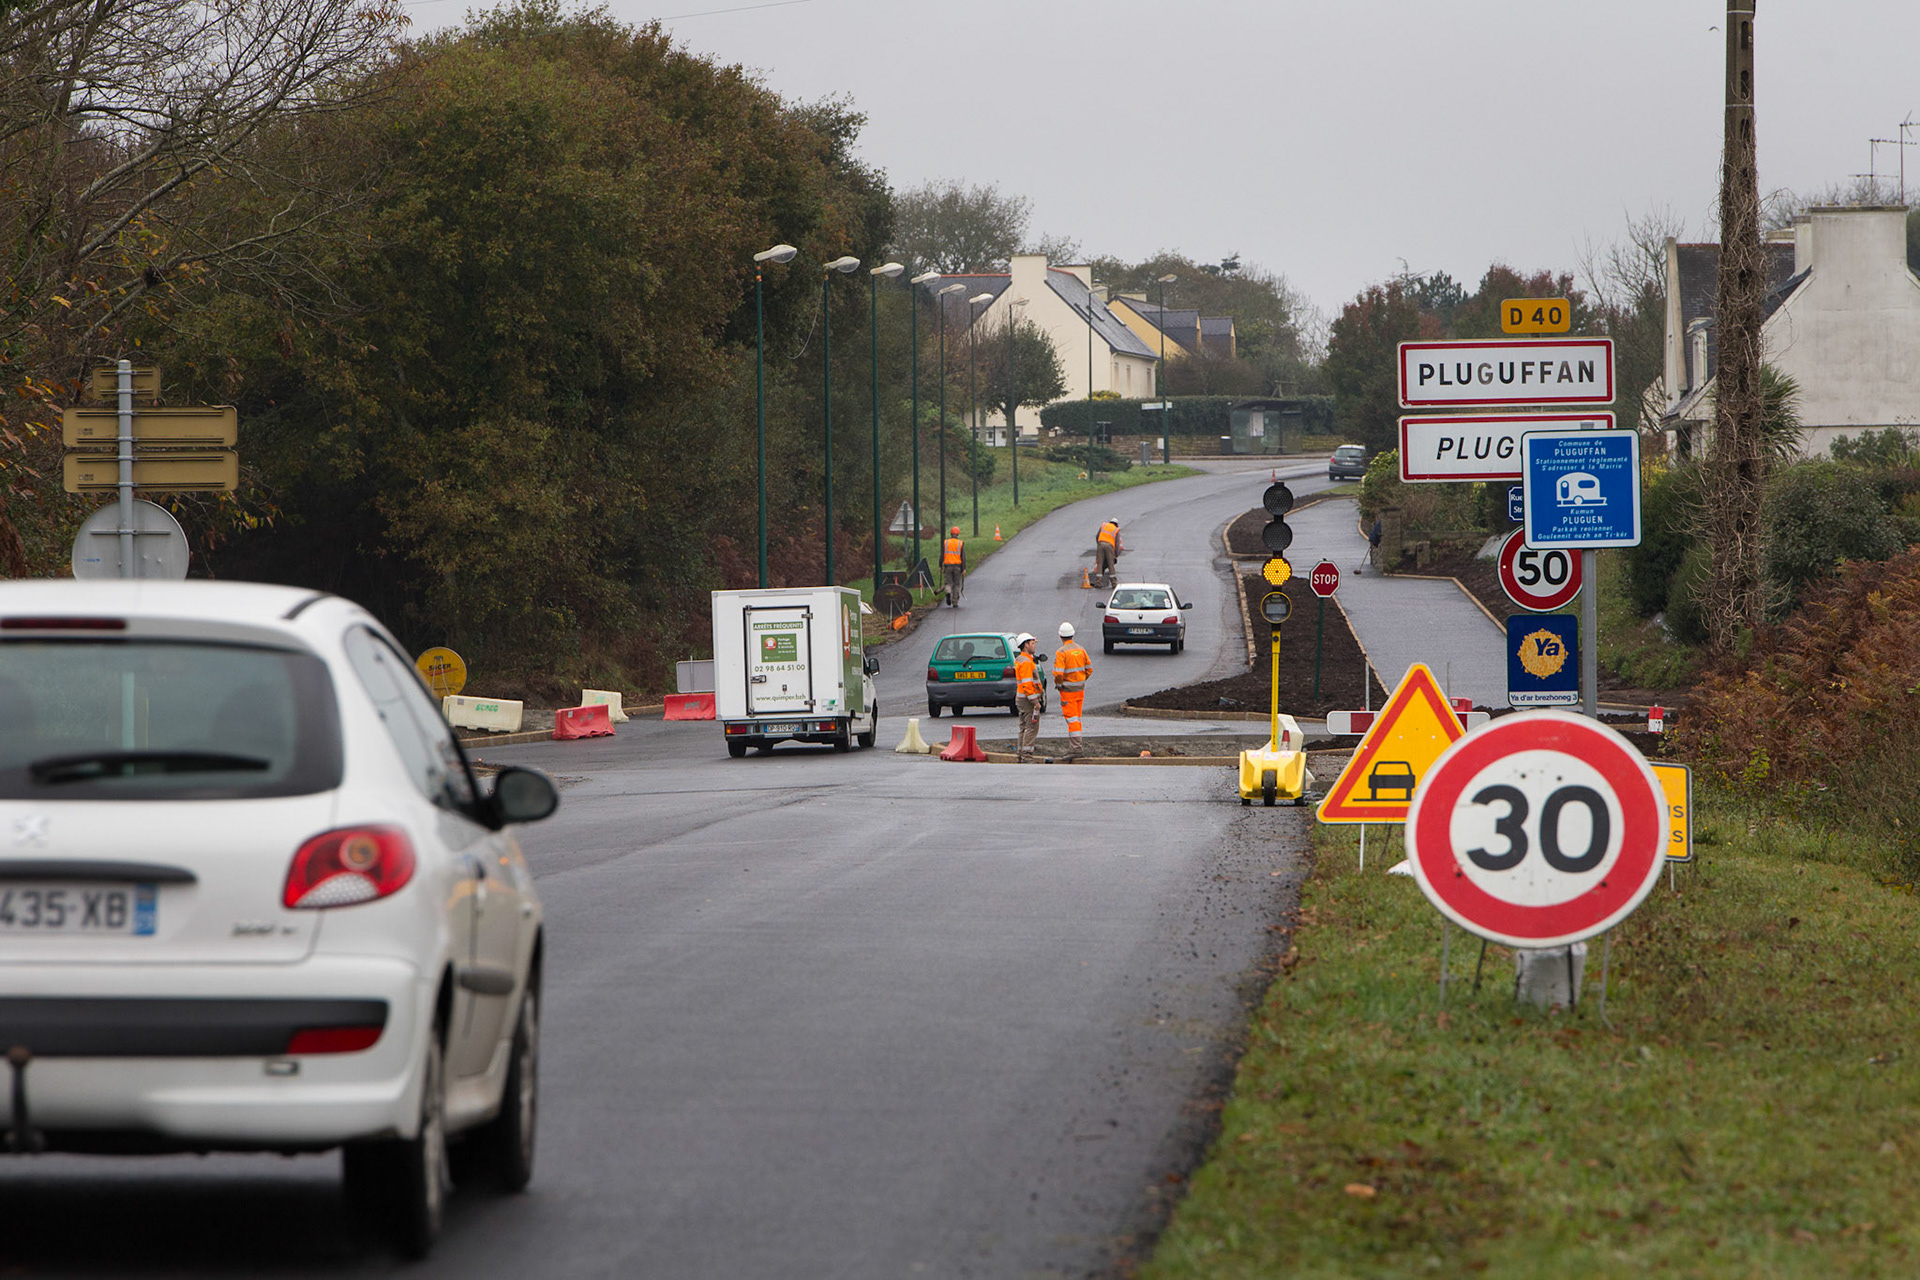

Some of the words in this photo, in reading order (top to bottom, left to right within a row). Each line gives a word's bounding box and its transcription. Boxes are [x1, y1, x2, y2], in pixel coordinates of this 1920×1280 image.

[1510, 308, 1522, 325] D
[1532, 307, 1562, 325] 40
[1418, 360, 1595, 386] PLUGUFFAN
[1437, 436, 1523, 460] PLUG
[1554, 447, 1606, 457] PLUGUFFAN
[1535, 457, 1585, 465] Stationnement
[1598, 462, 1622, 470] Mairie
[1562, 515, 1603, 524] PLUGUEN
[1518, 550, 1568, 586] 50
[1313, 573, 1338, 585] STOP
[1534, 638, 1560, 657] Ya
[755, 693, 807, 702] www.quimper.bzh
[1535, 694, 1571, 702] brezhoneg
[1572, 693, 1578, 701] 3
[1466, 783, 1611, 873] 30
